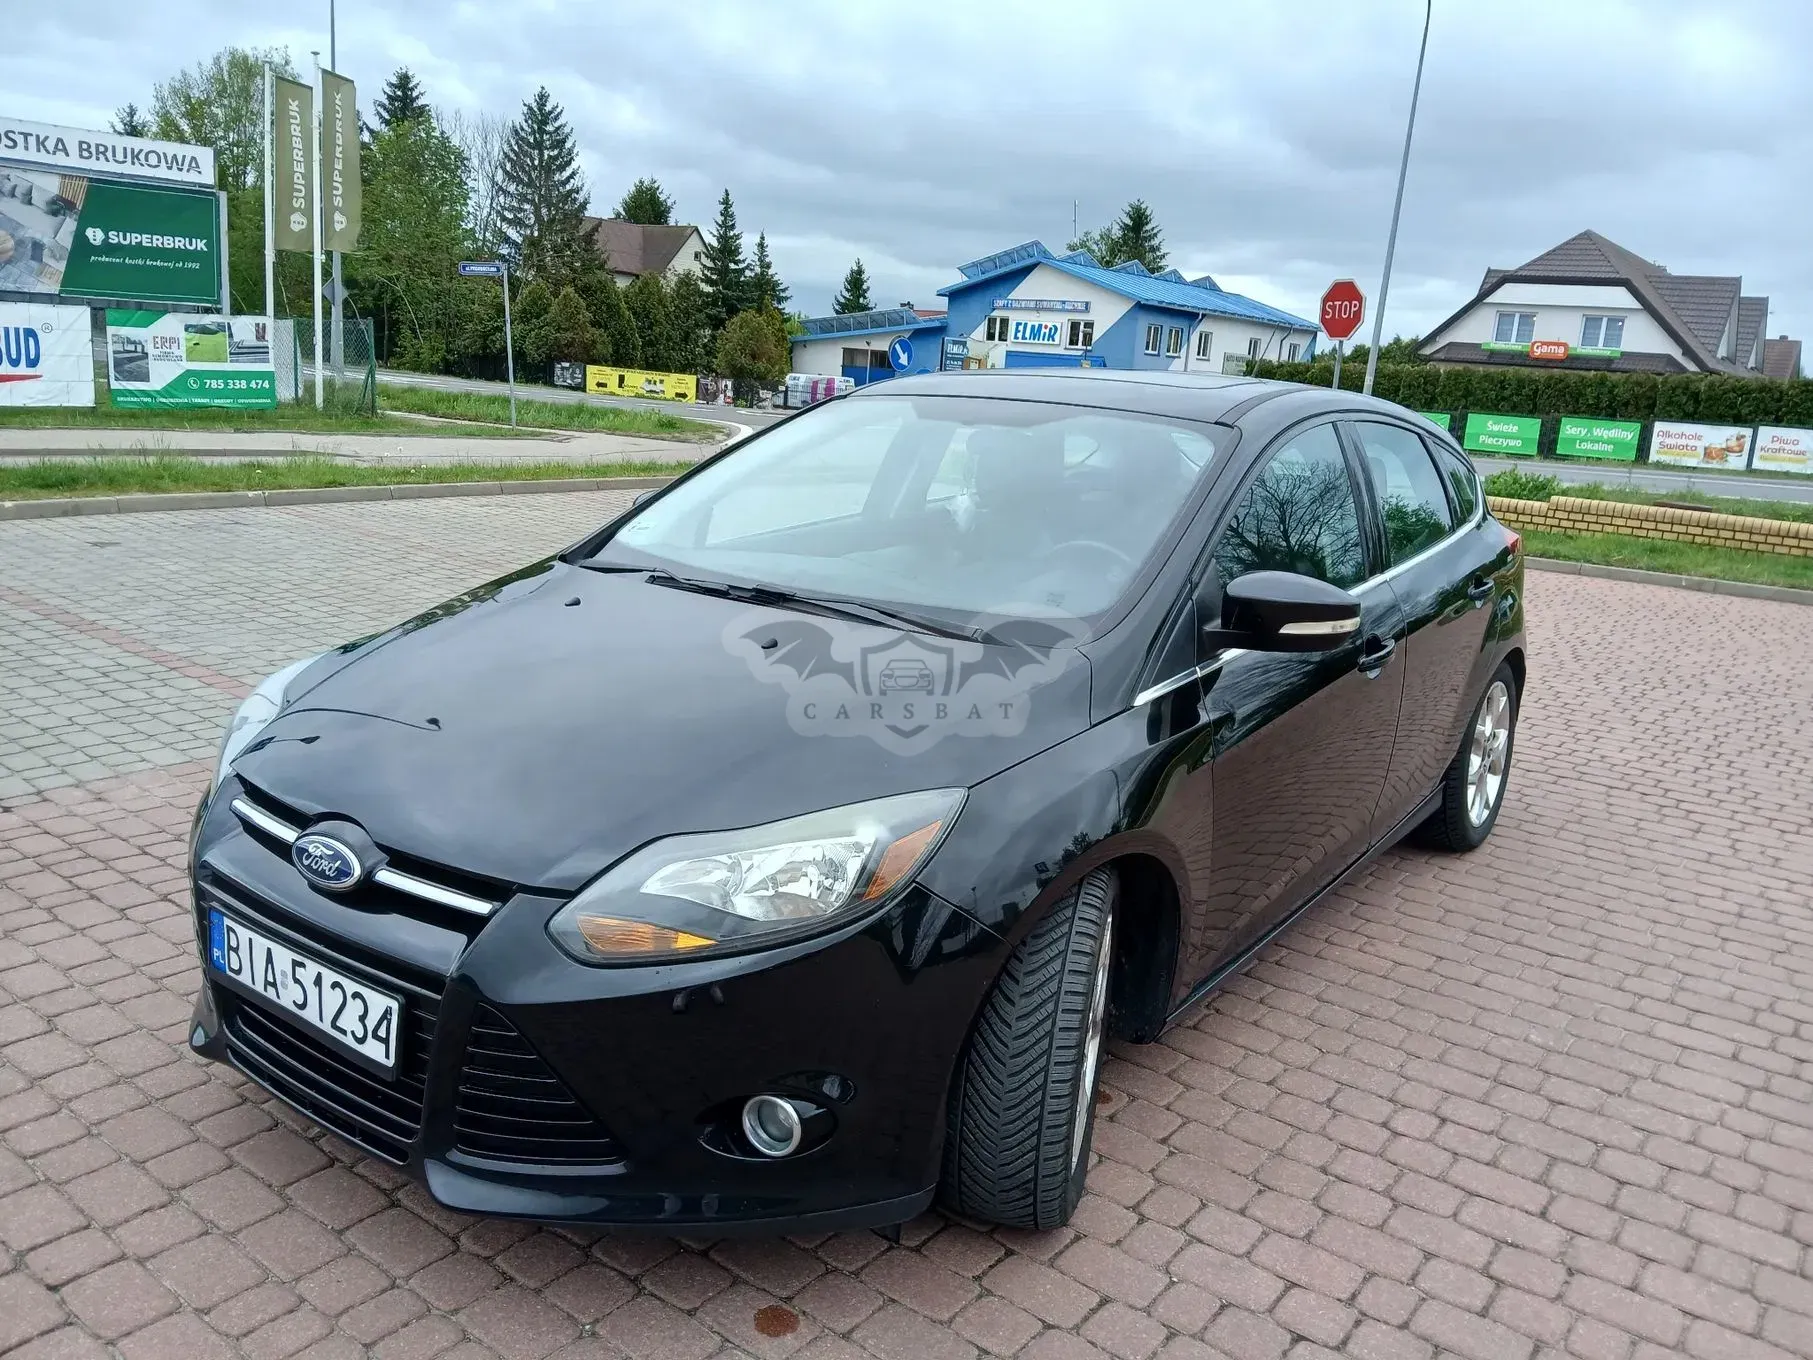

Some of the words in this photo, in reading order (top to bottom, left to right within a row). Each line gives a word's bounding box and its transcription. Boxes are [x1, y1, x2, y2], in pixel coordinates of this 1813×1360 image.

[0, 129, 70, 157] STKA
[78, 140, 202, 175] BRUKOWA
[288, 97, 305, 209] SUPERBRUK
[108, 230, 208, 251] SUPERBRUK
[90, 254, 123, 263] producent
[125, 256, 145, 266] kostki
[146, 258, 174, 268] brukowej
[1325, 300, 1359, 319] STOP
[0, 326, 41, 368] UD
[153, 336, 180, 350] ERPI
[204, 380, 224, 389] 785
[227, 380, 247, 389] 338
[249, 380, 270, 389] 474
[1486, 420, 1519, 433] Świeże
[1593, 428, 1634, 440] Wędliny
[1656, 430, 1703, 441] Alkohole
[1771, 435, 1800, 446] Piwa
[1479, 435, 1522, 448] Pieczywo
[1576, 440, 1614, 452] Lokalne
[1658, 440, 1698, 452] Świata
[1760, 445, 1807, 456] Kraftowe
[301, 842, 341, 878] Ford
[213, 947, 225, 964] PL
[226, 924, 281, 1001] BIA
[291, 958, 393, 1060] 51234
